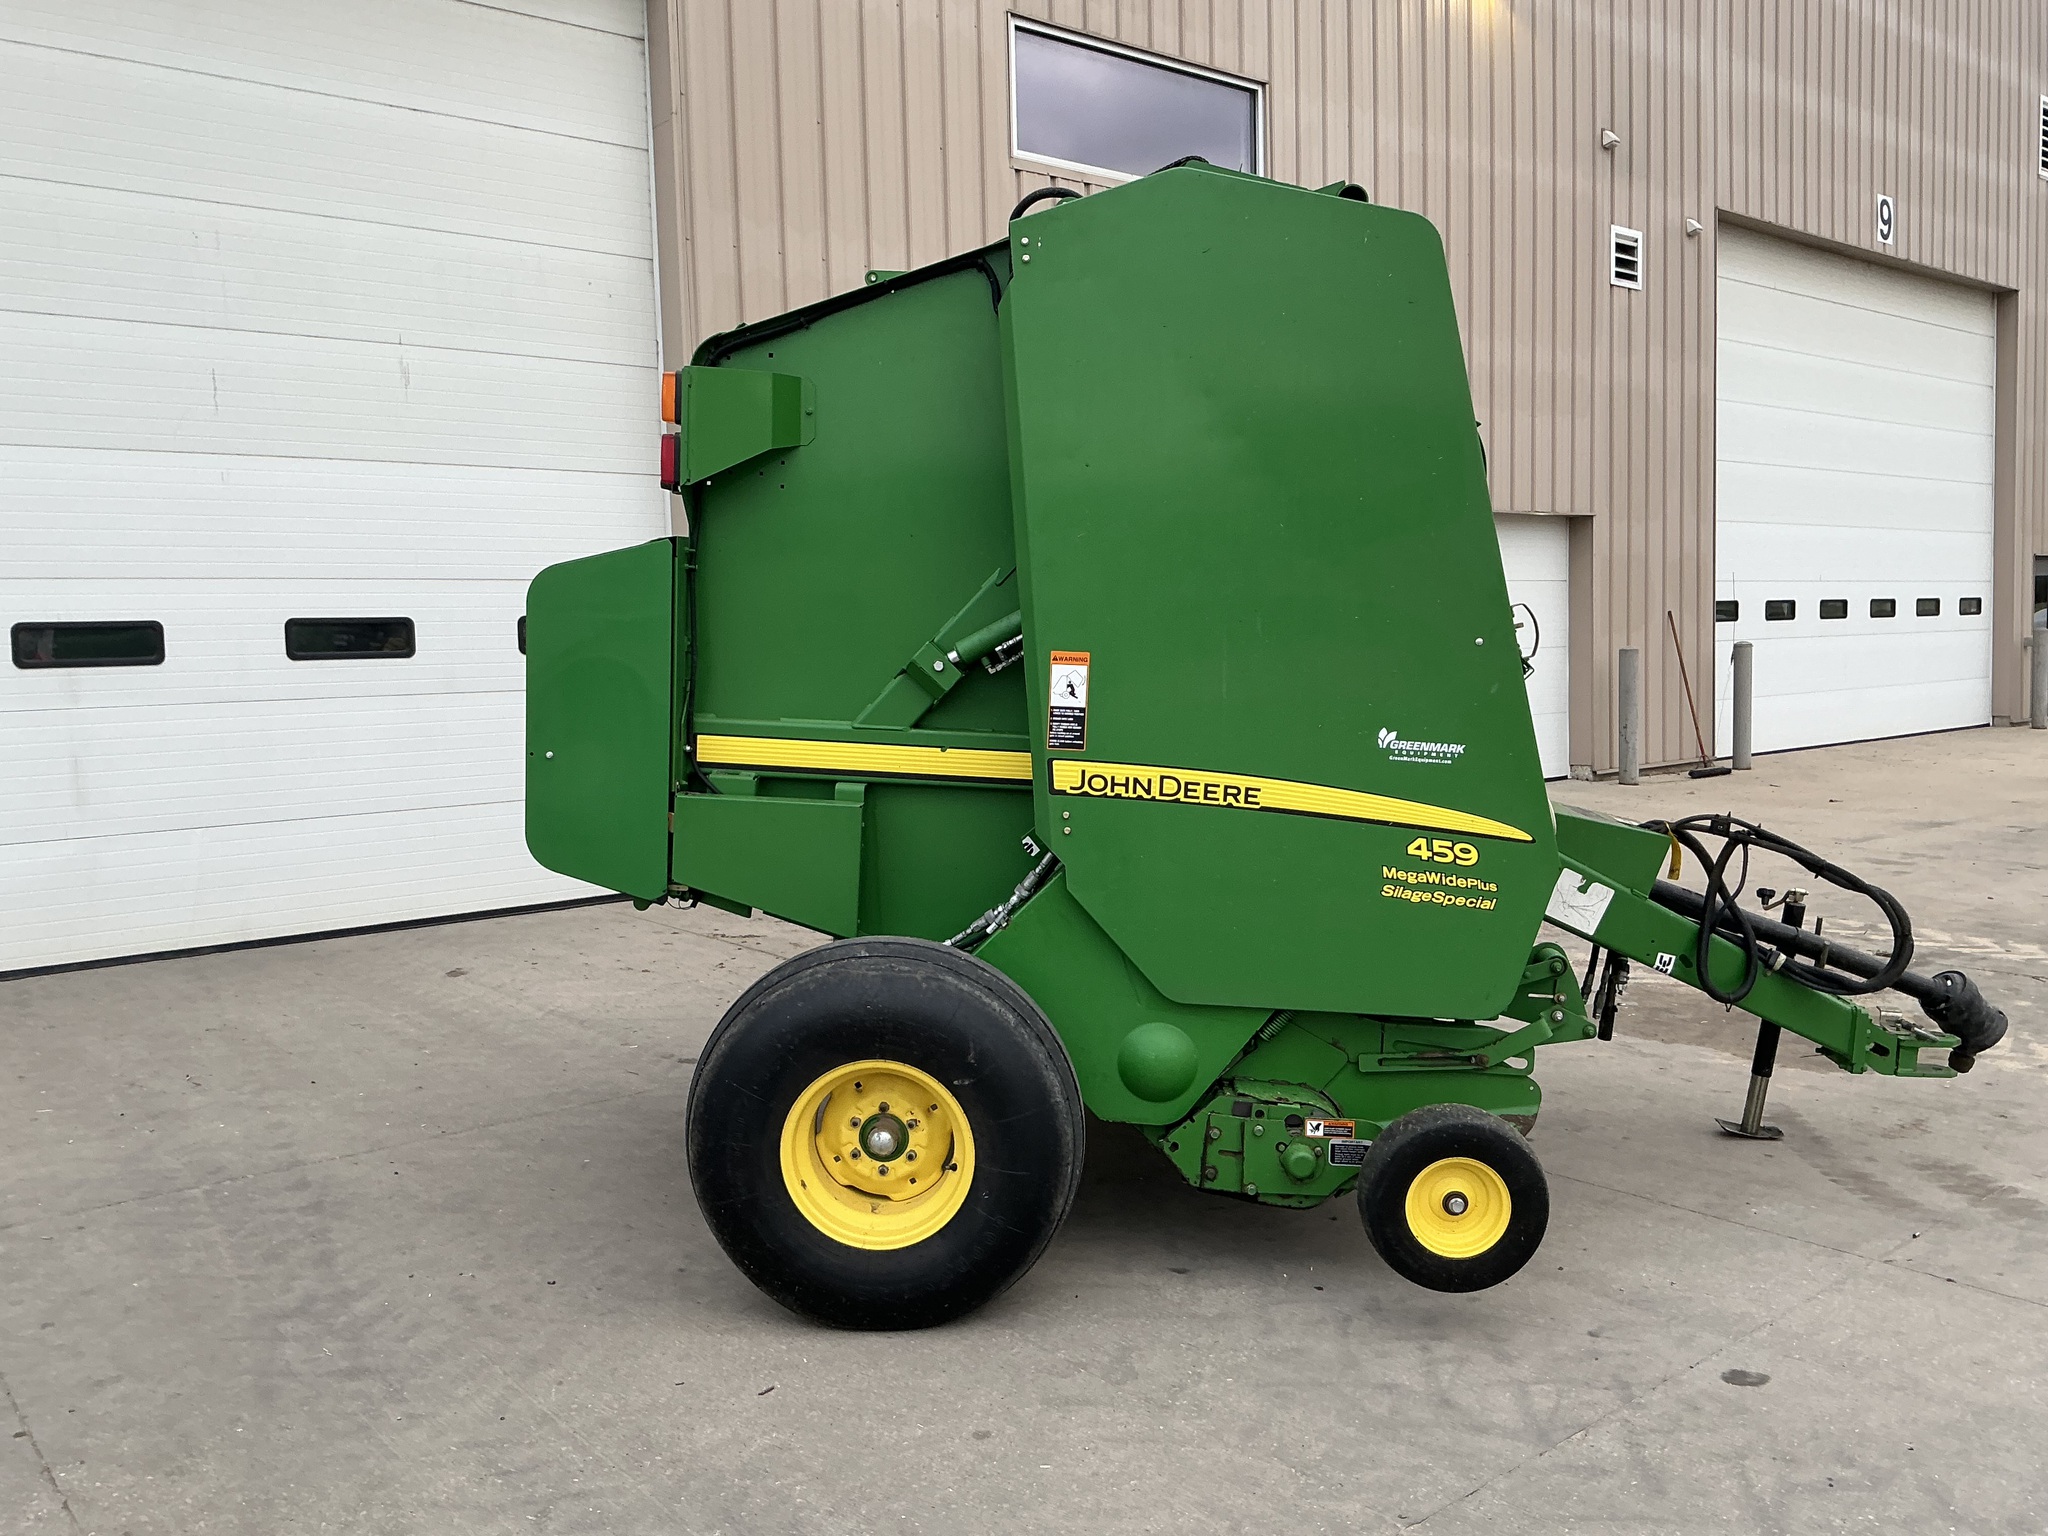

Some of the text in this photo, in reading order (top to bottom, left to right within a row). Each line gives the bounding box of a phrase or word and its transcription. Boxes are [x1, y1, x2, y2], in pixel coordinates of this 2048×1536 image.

[1880, 199, 1892, 241] 9
[1058, 655, 1088, 663] WARNING
[1390, 740, 1466, 753] GREENMARK
[1394, 750, 1459, 758] EQUIPMENT
[1069, 769, 1262, 806] JOHN DEERE
[1406, 836, 1479, 867] 459
[1382, 866, 1498, 892] MegaWidePlus
[1381, 884, 1497, 910] SilageSpecial
